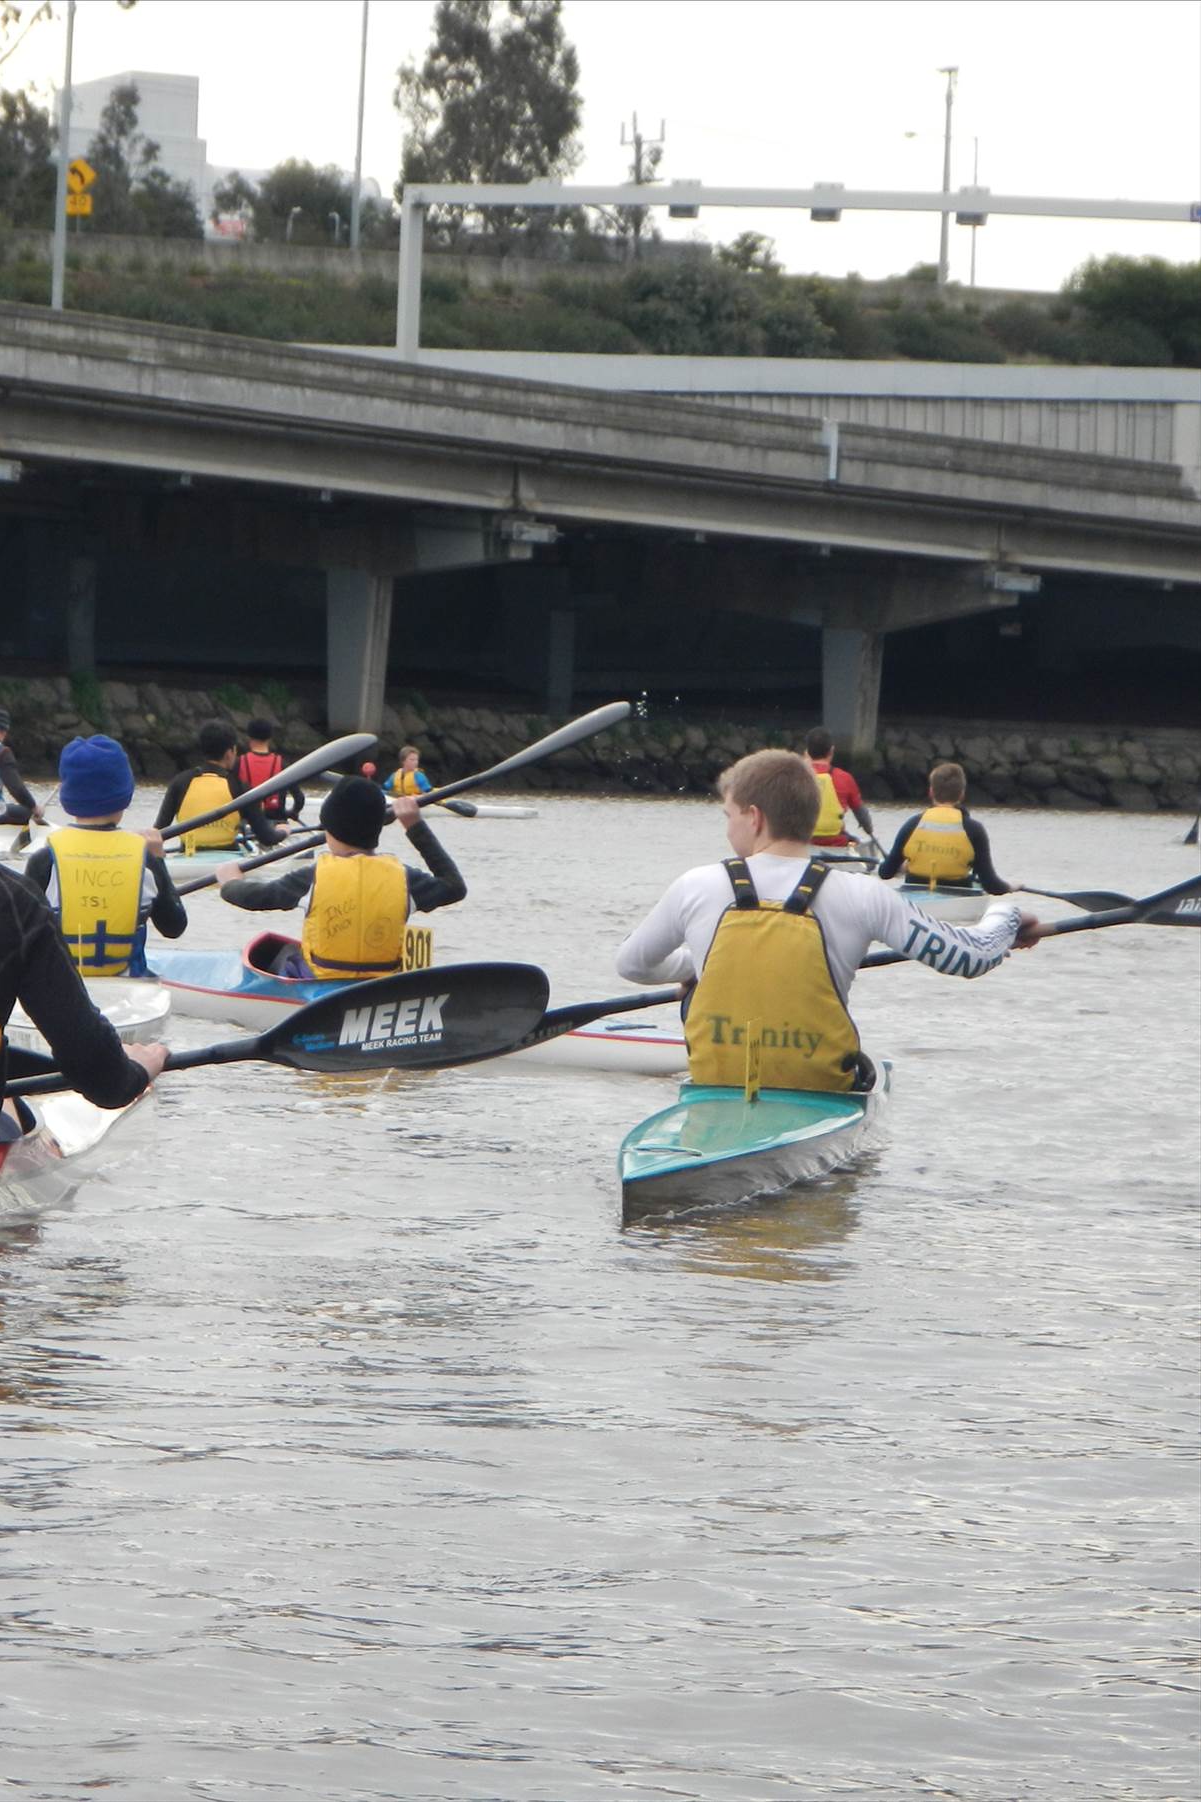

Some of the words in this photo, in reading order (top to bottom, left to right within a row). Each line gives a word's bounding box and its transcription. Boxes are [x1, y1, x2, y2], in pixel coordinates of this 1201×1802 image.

[405, 929, 433, 970] 901
[338, 993, 451, 1046] MEEK
[707, 1014, 825, 1059] Trnity
[361, 1039, 385, 1051] MEEK
[385, 1035, 418, 1047] RACING
[419, 1032, 443, 1043] TEAM
